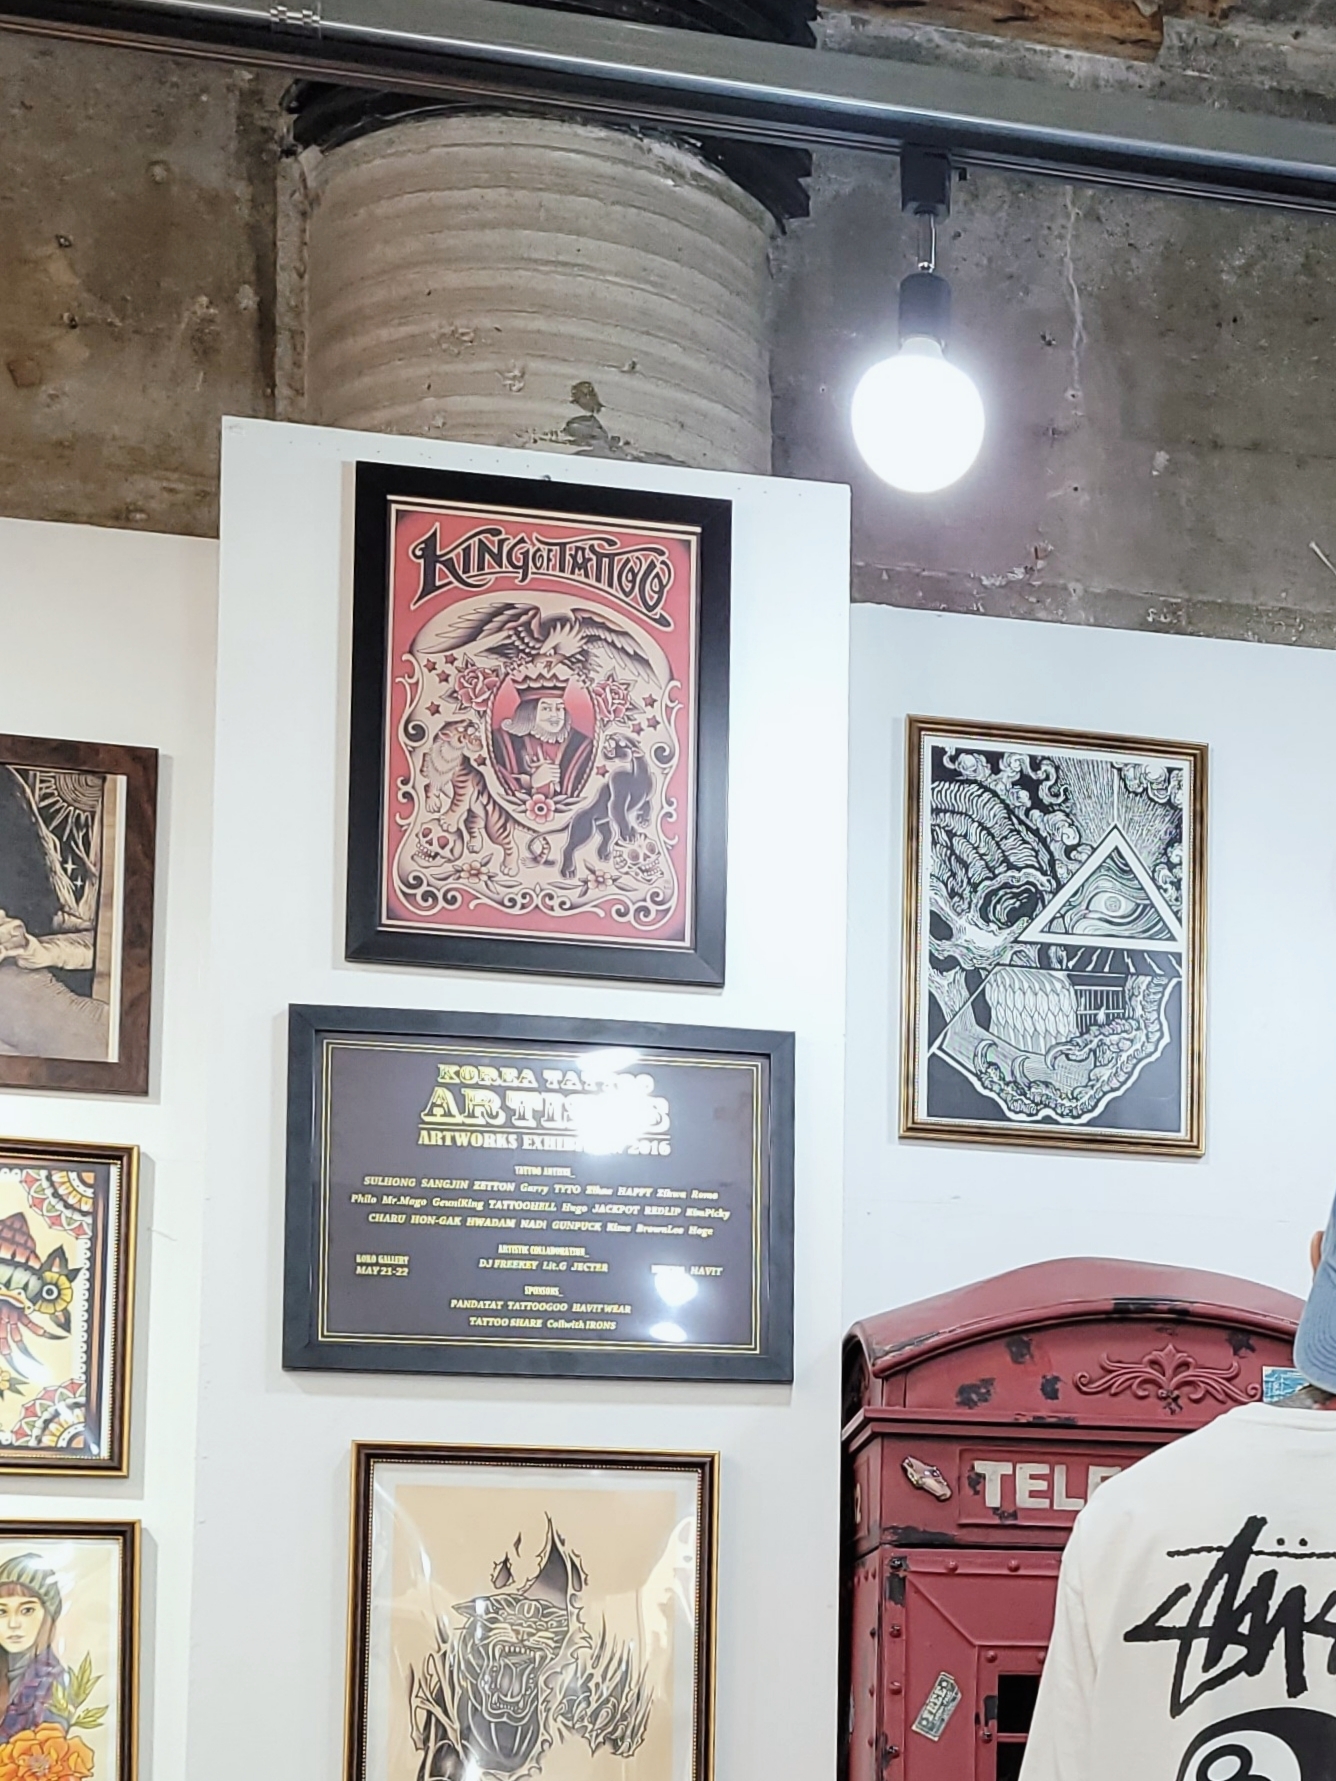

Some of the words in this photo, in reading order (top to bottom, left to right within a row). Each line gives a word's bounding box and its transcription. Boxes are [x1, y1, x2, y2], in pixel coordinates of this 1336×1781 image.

[437, 1063, 538, 1088] KOREA
[420, 1086, 671, 1133] ARTIS
[418, 1130, 518, 1149] ARTWORKS
